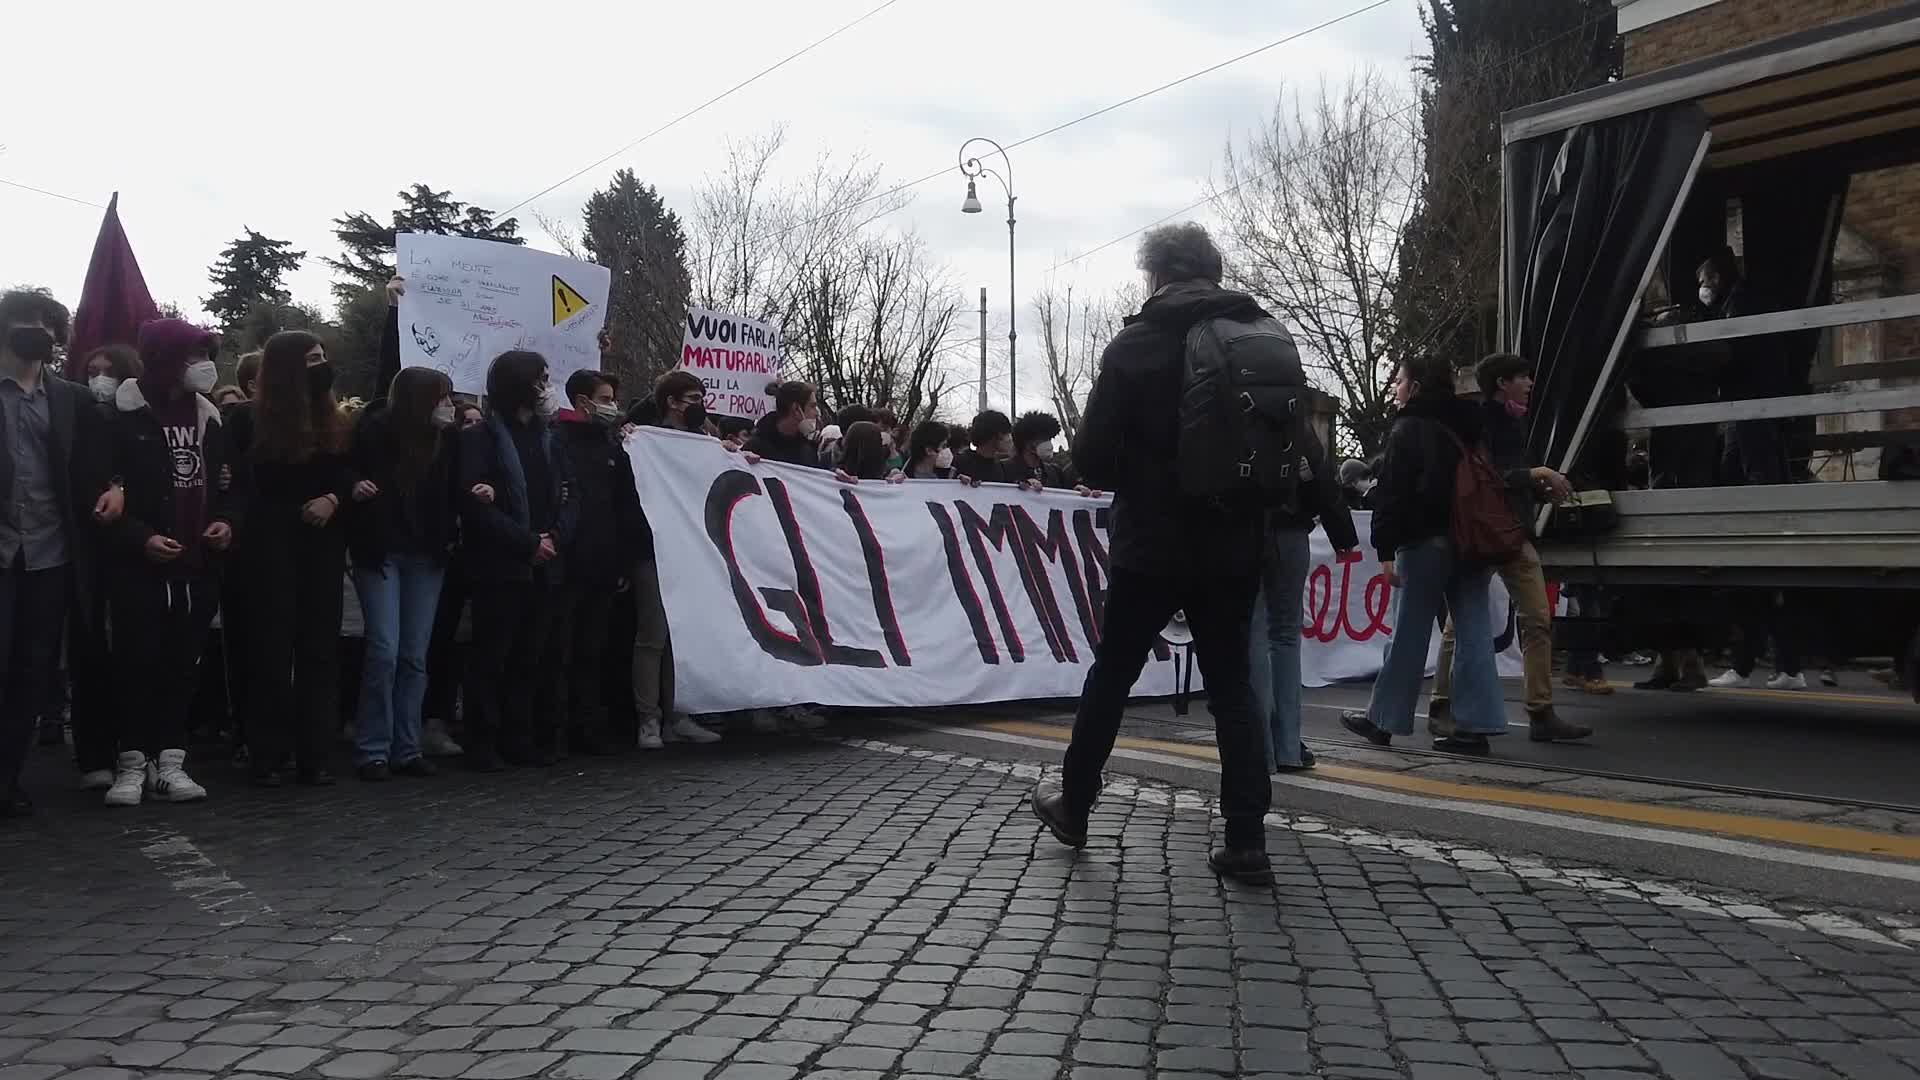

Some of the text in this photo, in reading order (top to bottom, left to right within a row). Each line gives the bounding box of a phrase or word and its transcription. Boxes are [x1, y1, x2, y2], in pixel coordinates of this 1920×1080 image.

[688, 313, 776, 351] VUOI FARLA
[683, 343, 777, 374] MATURARLA?
[702, 377, 740, 390] GLI LA
[729, 394, 768, 416] PROVA
[704, 469, 1112, 668] GLI IMMA
